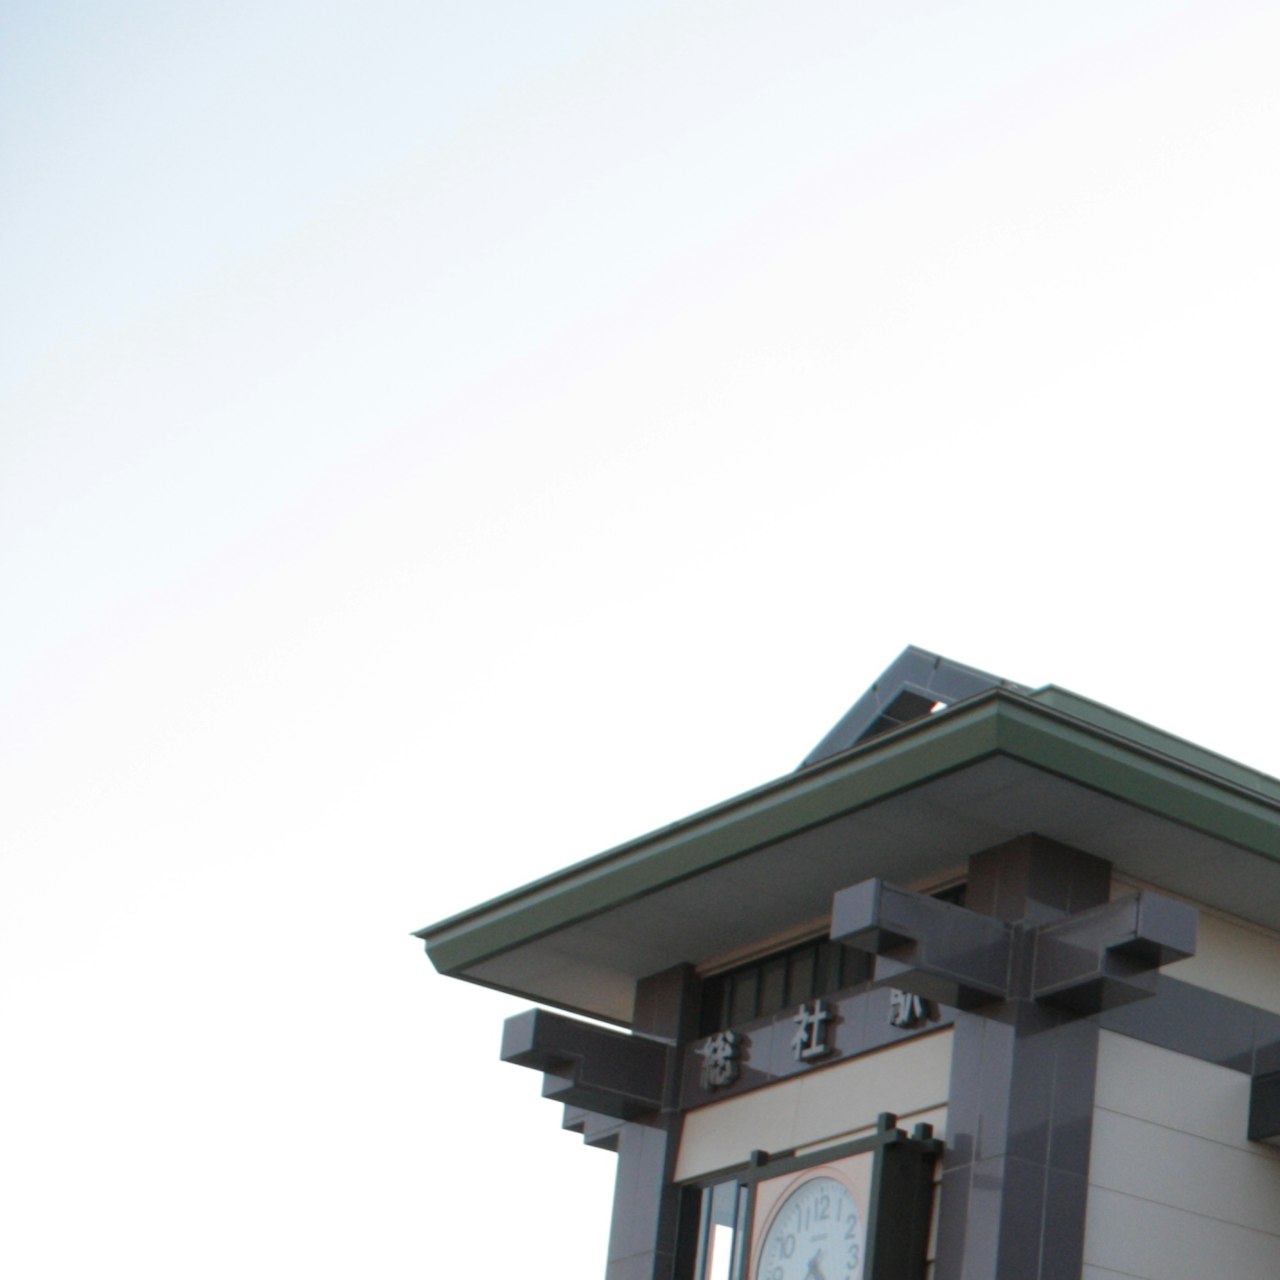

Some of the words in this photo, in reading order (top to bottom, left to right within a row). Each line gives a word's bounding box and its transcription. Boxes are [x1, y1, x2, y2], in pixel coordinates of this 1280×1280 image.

[796, 1206, 812, 1234] 11
[814, 1194, 831, 1220] 12
[844, 1214, 857, 1239] 2
[776, 1234, 796, 1260] 10
[846, 1244, 859, 1269] 3
